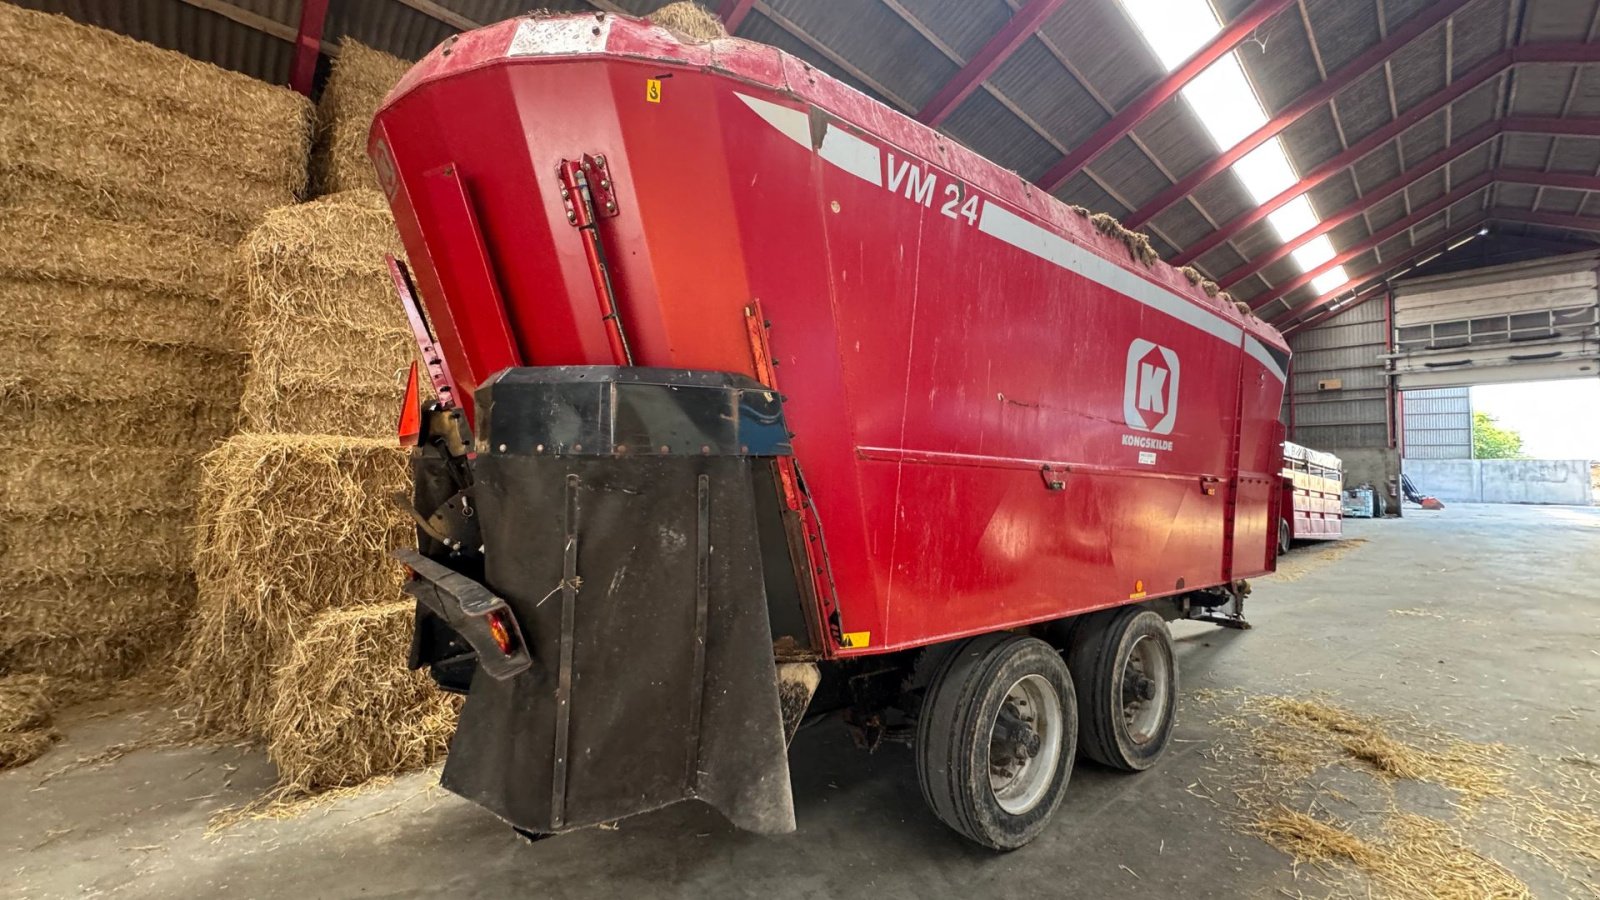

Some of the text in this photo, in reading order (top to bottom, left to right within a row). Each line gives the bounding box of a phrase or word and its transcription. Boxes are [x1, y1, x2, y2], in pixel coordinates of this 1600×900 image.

[887, 153, 979, 226] VM 24
[1138, 362, 1168, 414] K
[1122, 434, 1173, 451] KONGSKILDE
